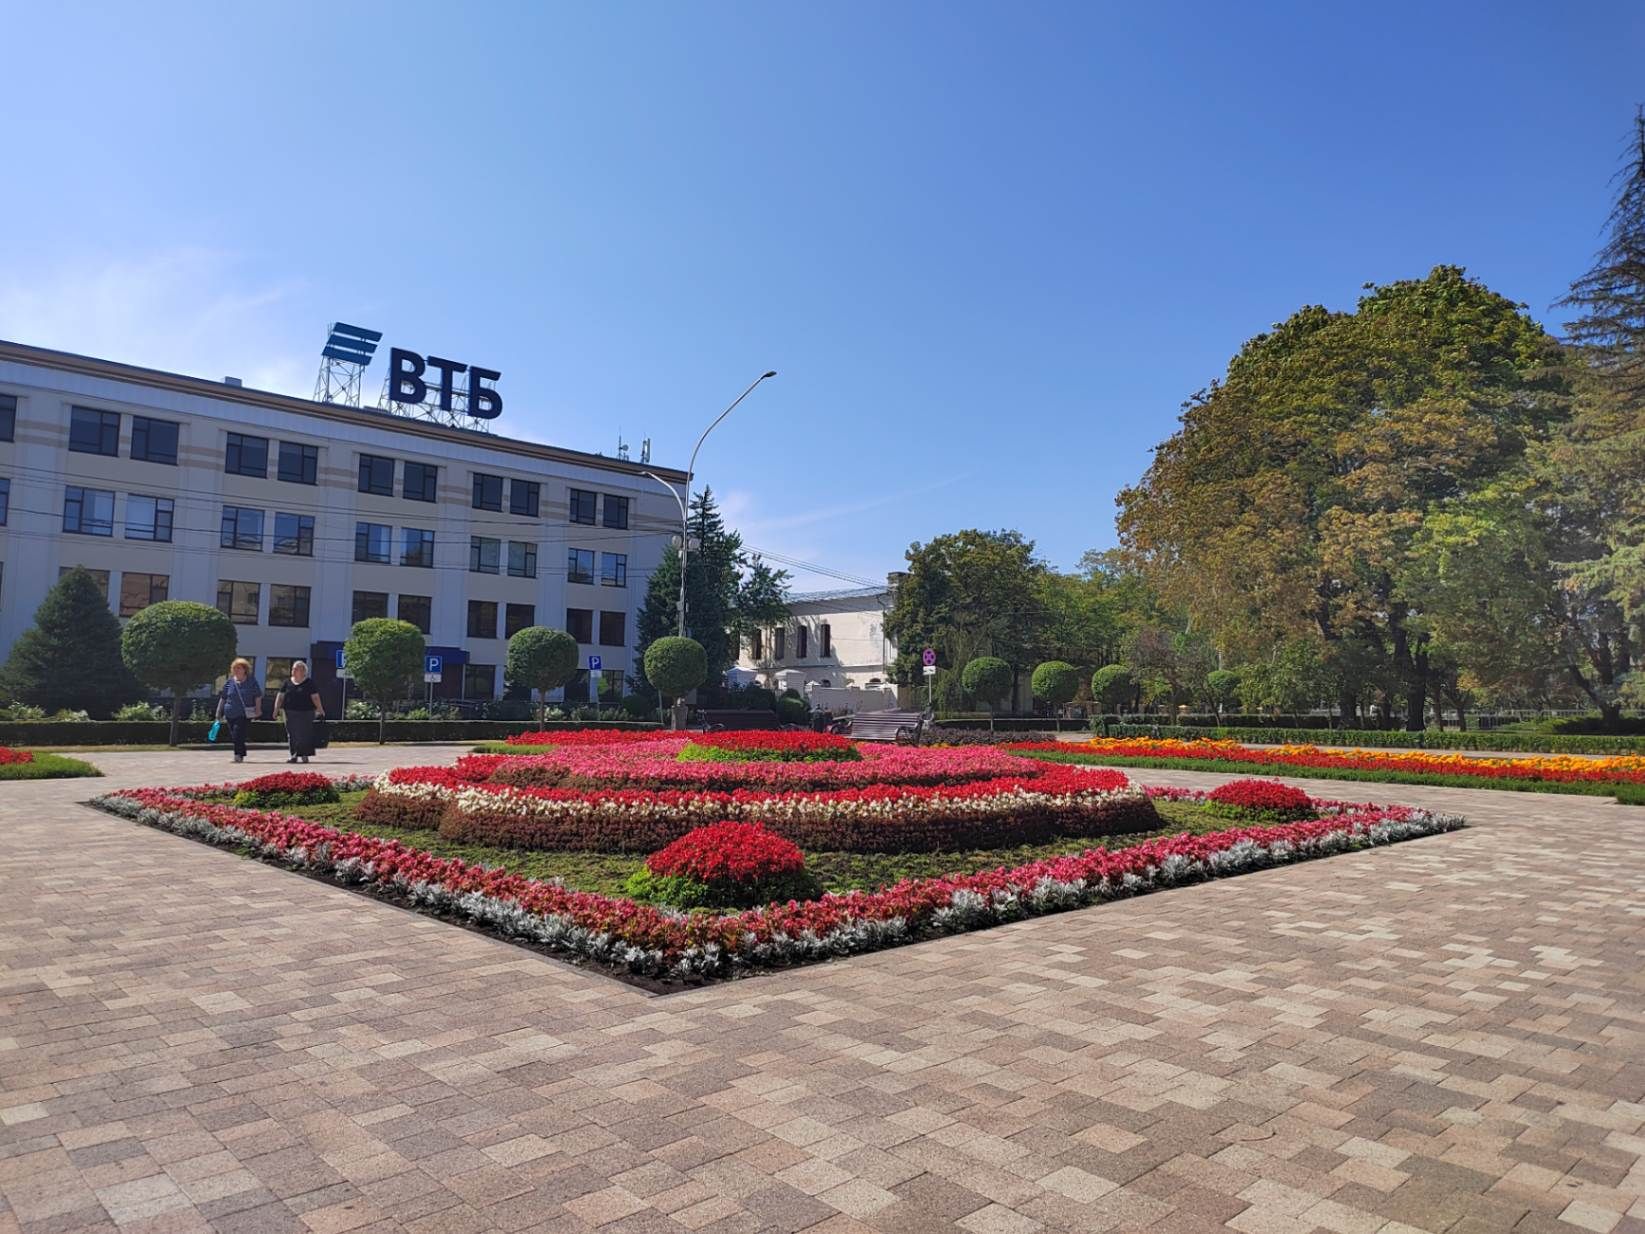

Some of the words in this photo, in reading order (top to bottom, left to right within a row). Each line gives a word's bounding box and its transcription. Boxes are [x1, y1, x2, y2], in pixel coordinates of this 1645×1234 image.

[389, 347, 503, 419] ВТБ
[429, 657, 439, 671] P
[591, 656, 600, 669] P
